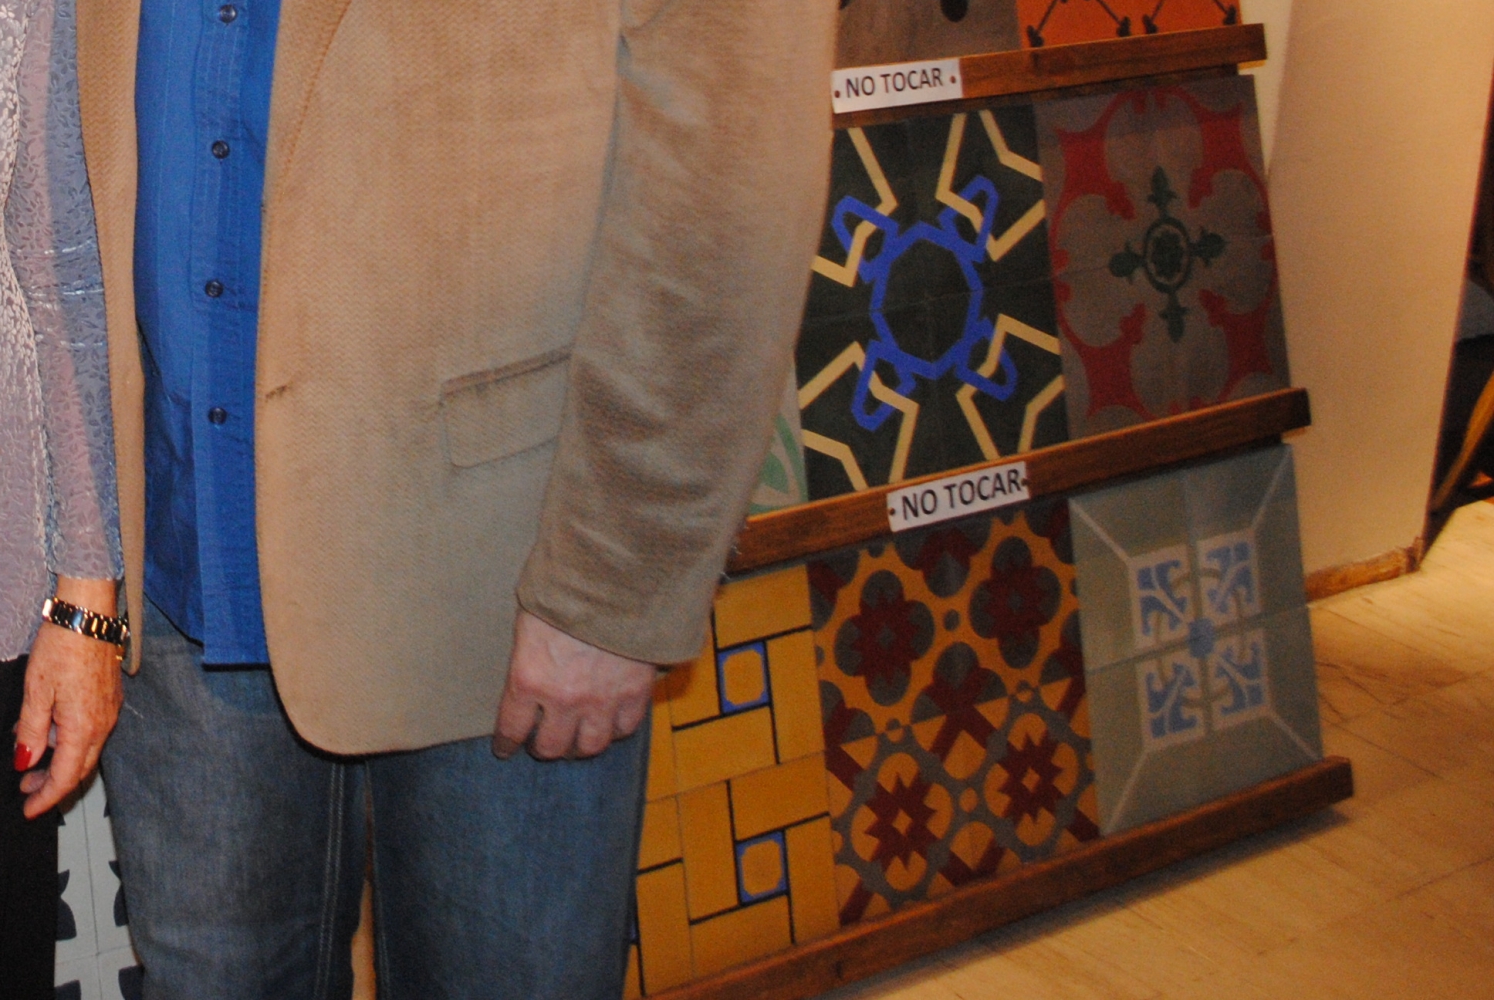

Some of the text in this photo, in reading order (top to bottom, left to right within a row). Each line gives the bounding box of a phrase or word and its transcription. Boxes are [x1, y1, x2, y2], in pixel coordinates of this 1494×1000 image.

[846, 67, 943, 98] NO TOCAR
[901, 468, 1022, 520] NO TOCAR
